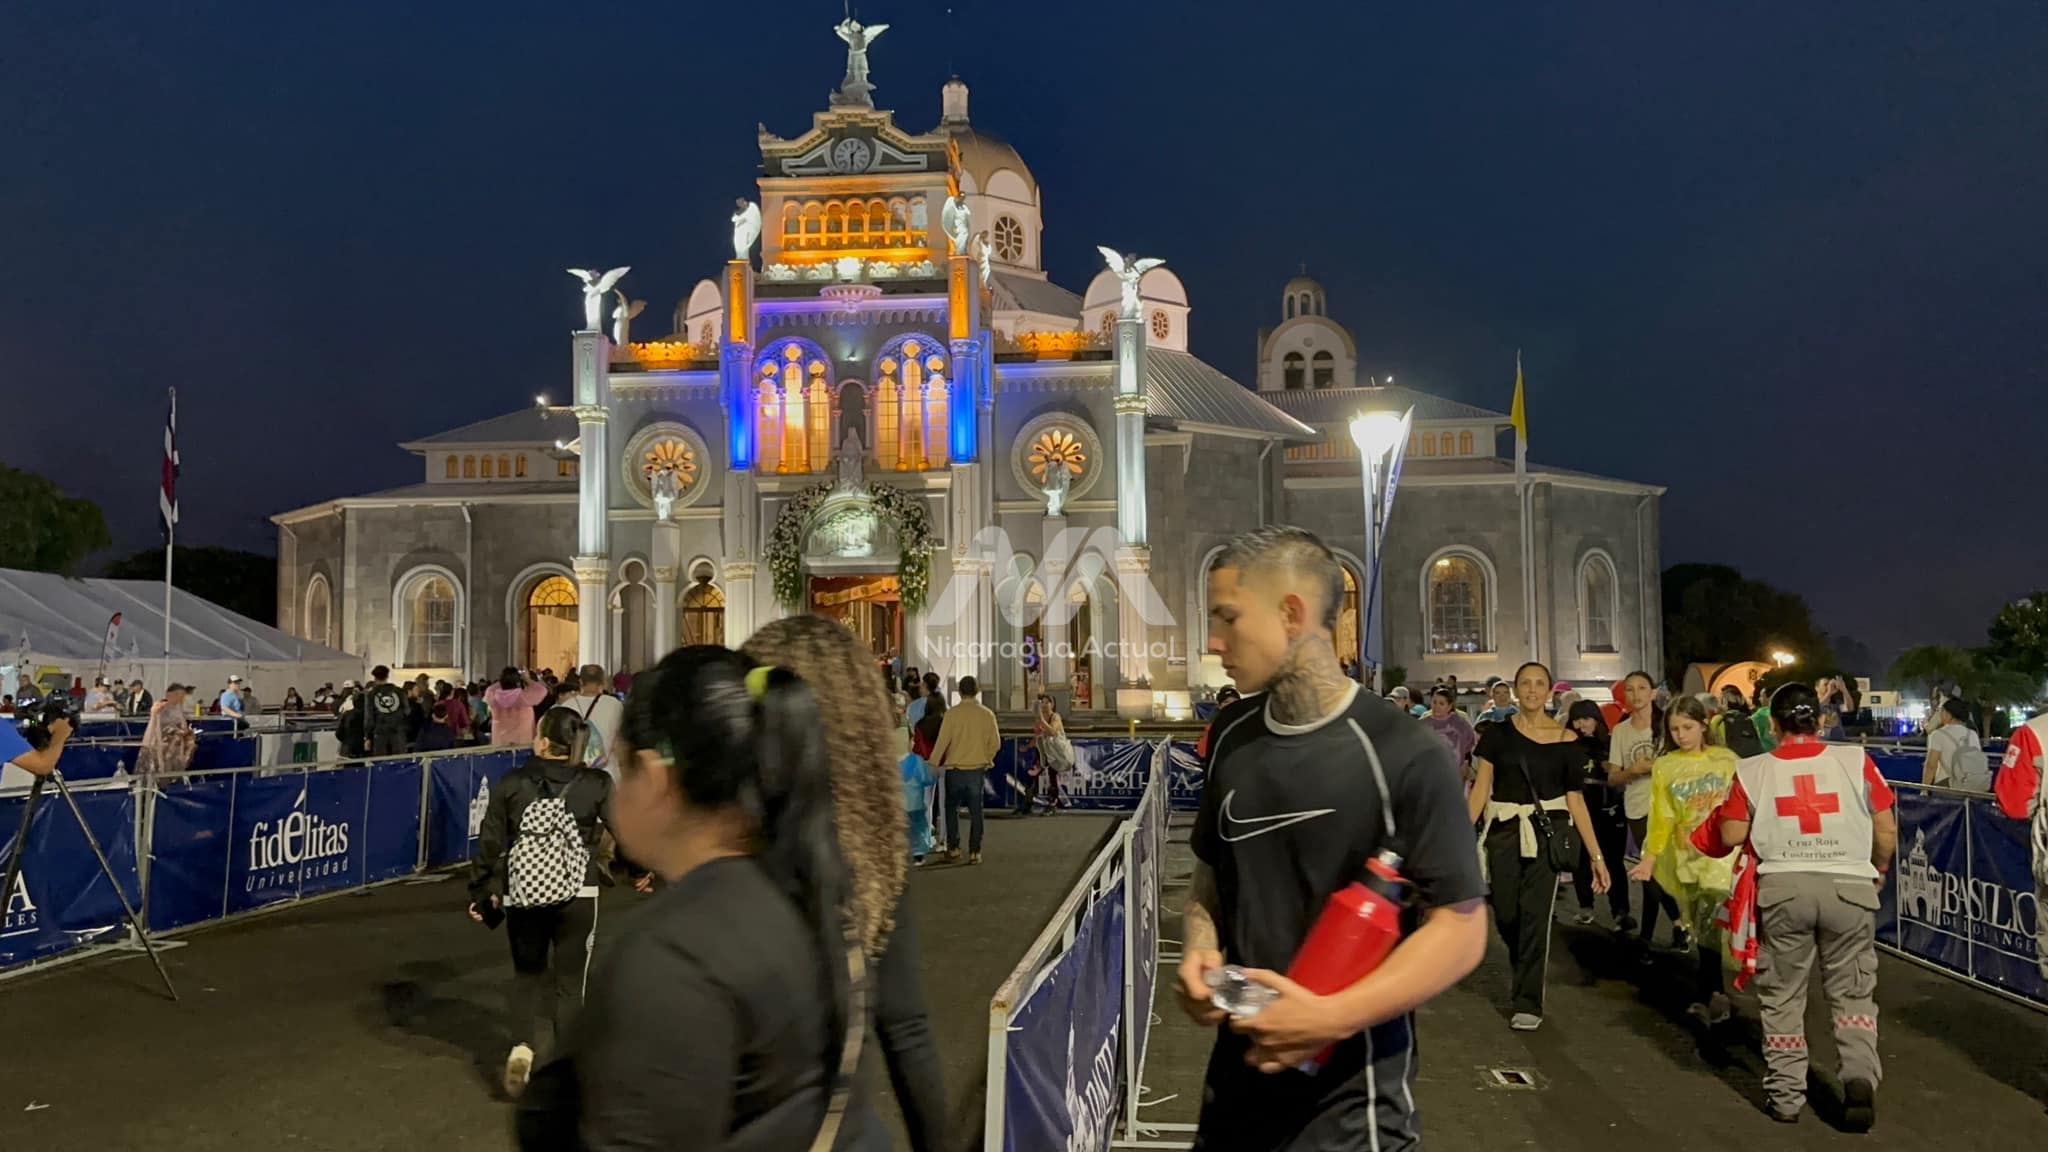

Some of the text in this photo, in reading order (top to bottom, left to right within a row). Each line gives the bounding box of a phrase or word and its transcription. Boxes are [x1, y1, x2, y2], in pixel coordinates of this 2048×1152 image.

[248, 788, 349, 871] fidélitas
[245, 856, 348, 892] Univesidad
[1941, 872, 2038, 938] BASILIC
